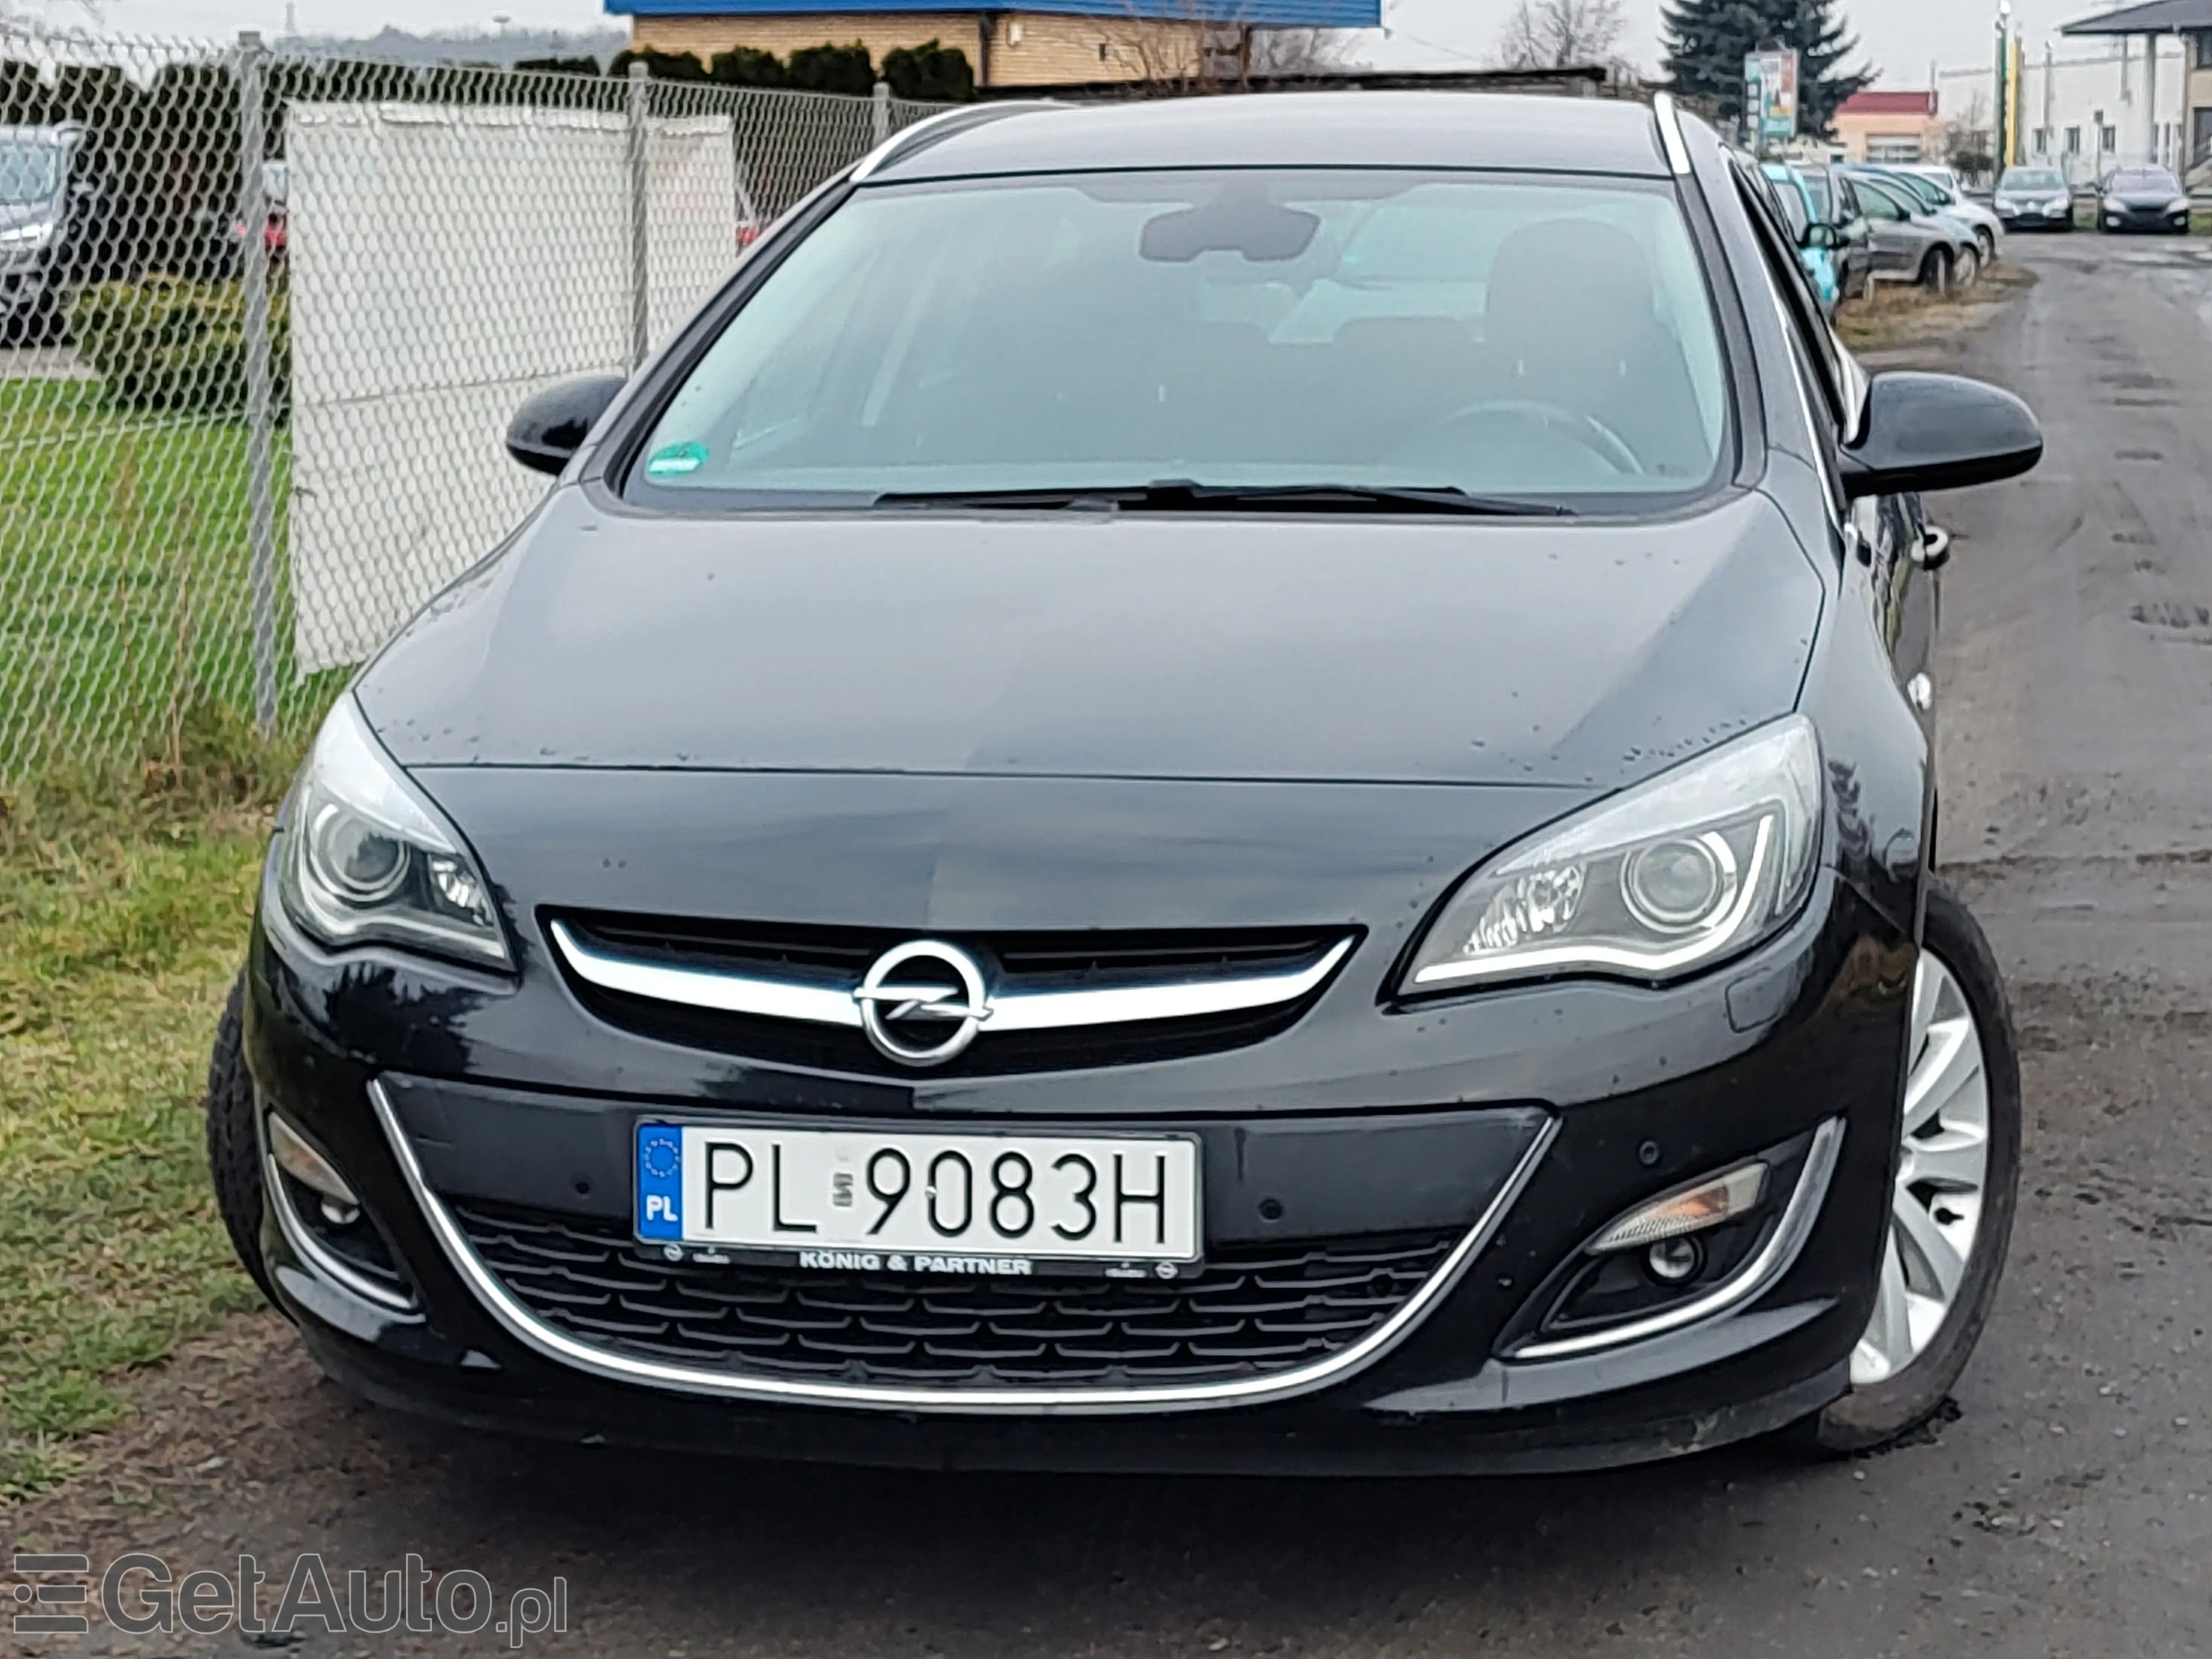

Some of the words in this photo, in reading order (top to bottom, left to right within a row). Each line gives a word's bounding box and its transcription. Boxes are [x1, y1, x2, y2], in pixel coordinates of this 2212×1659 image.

[704, 1142, 818, 1233] PL
[865, 1148, 1166, 1244] 9083H
[646, 1195, 678, 1221] PL
[800, 1251, 881, 1271] KÖNIG
[887, 1254, 908, 1271] &
[915, 1257, 1033, 1275] PARTNER
